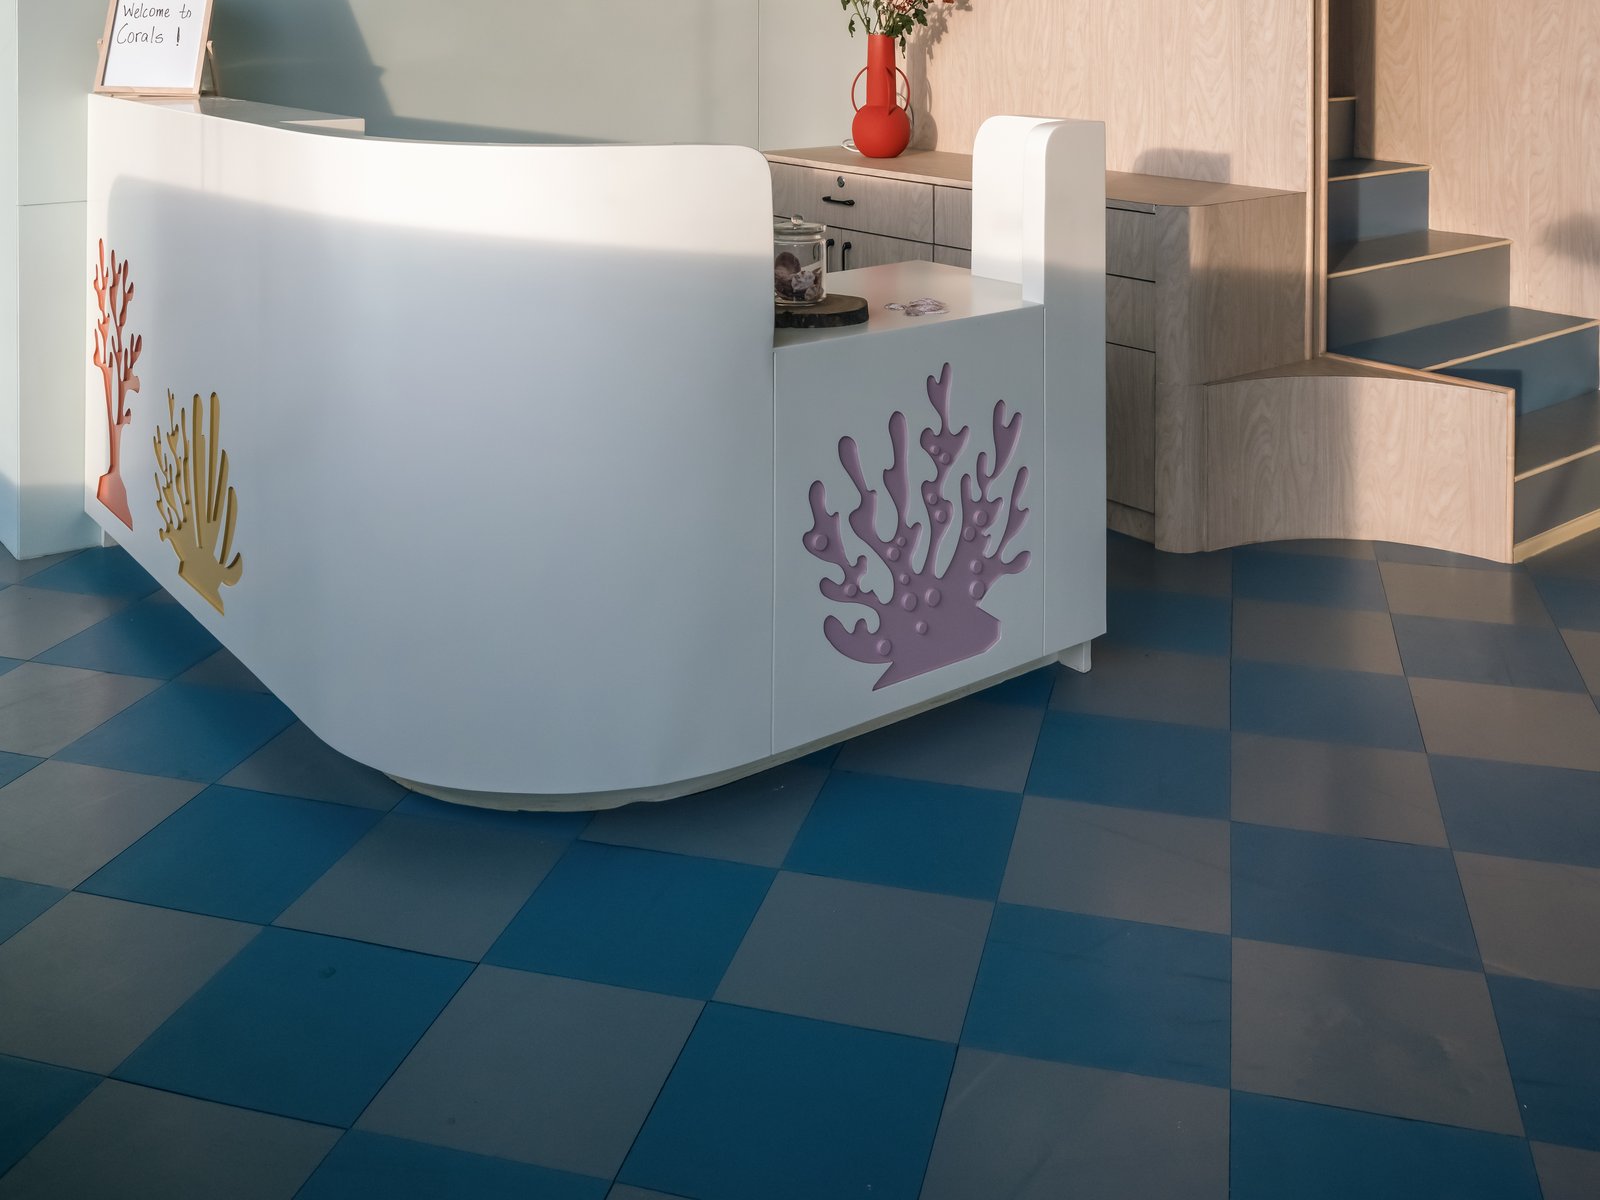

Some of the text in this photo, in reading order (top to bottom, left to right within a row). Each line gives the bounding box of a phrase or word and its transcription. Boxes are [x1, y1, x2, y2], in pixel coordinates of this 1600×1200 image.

[123, 3, 192, 19] Welcome to
[116, 23, 164, 44] Corals
